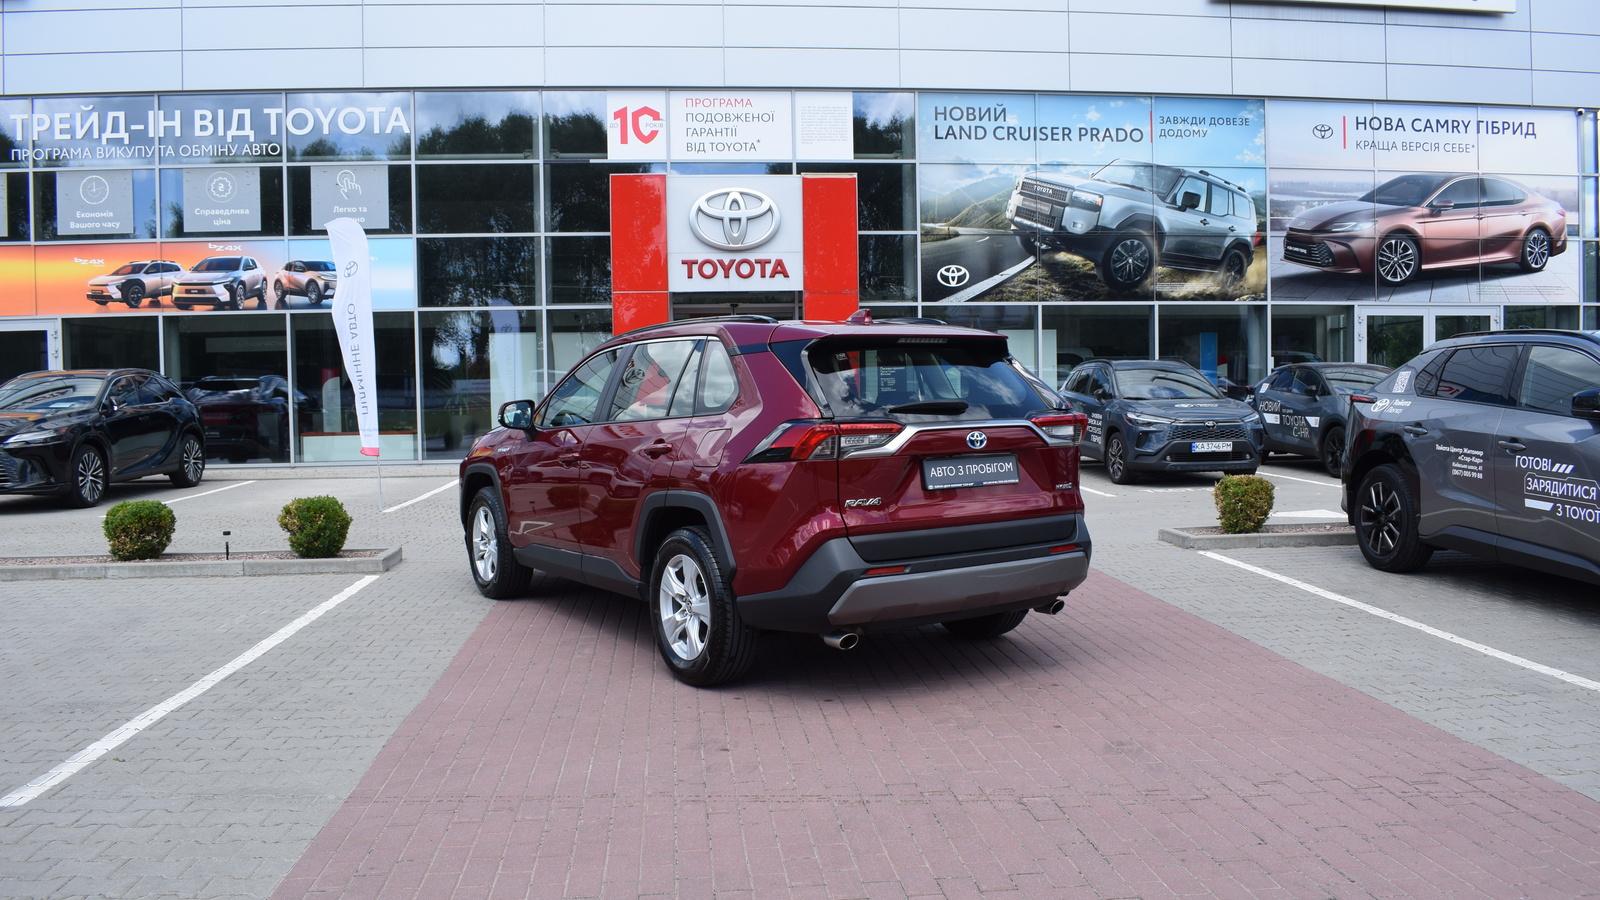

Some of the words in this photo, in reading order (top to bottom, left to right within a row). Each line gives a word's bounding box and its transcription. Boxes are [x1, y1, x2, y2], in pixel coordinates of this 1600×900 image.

[685, 98, 753, 109] ПРОГРАМА
[685, 111, 776, 125] ПОДОВЖЕНОЇ
[934, 103, 1008, 123] НОВИЙ
[10, 105, 182, 145] ТРЕЙД-ІН
[194, 109, 255, 142] ВІД
[263, 106, 411, 136] TOYOTA
[1158, 115, 1206, 128] ЗАВЖДИ
[1208, 116, 1250, 128] ДОВЕЗЕ
[1355, 116, 1406, 133] НОВА
[1412, 118, 1472, 135] CAMRY
[1477, 120, 1537, 140] ГІБРИД
[686, 125, 738, 138] ГАРАНТІЇ
[934, 125, 988, 142] LAND
[993, 125, 1073, 143] CRUISER
[1078, 127, 1144, 144] PRADO
[1158, 128, 1208, 140] ДОДОМУ
[11, 146, 93, 162] ПРОГРАМА
[96, 145, 155, 160] ВИКУПУ
[158, 144, 176, 158] ТА
[179, 143, 239, 158] ОБМІНУ
[242, 142, 282, 157] АВТО
[686, 142, 706, 154] ВІД
[1355, 140, 1399, 153] КРАЩА
[1401, 141, 1441, 153] ВЕРСІЯ
[1034, 185, 1053, 195] TOYOTA
[76, 210, 114, 219] Економія
[194, 207, 250, 217] Справедлива
[332, 205, 357, 214] Легко
[70, 221, 101, 229] Вашого
[102, 221, 121, 230] часу
[213, 217, 231, 226] ціна
[681, 258, 790, 280] TOYOTA
[1259, 400, 1281, 412] НОВИЙ
[1282, 414, 1306, 427] TOYOTA
[1292, 426, 1310, 438] C-HR
[930, 465, 956, 478] АВТО
[965, 461, 1014, 476] ПРОБІГОМ
[1515, 455, 1552, 472] ГОТОВІ
[1526, 477, 1597, 501] ЗАРЯДИТИСЯ
[844, 496, 882, 508] RAV4
[1564, 504, 1600, 524] TOYOT
